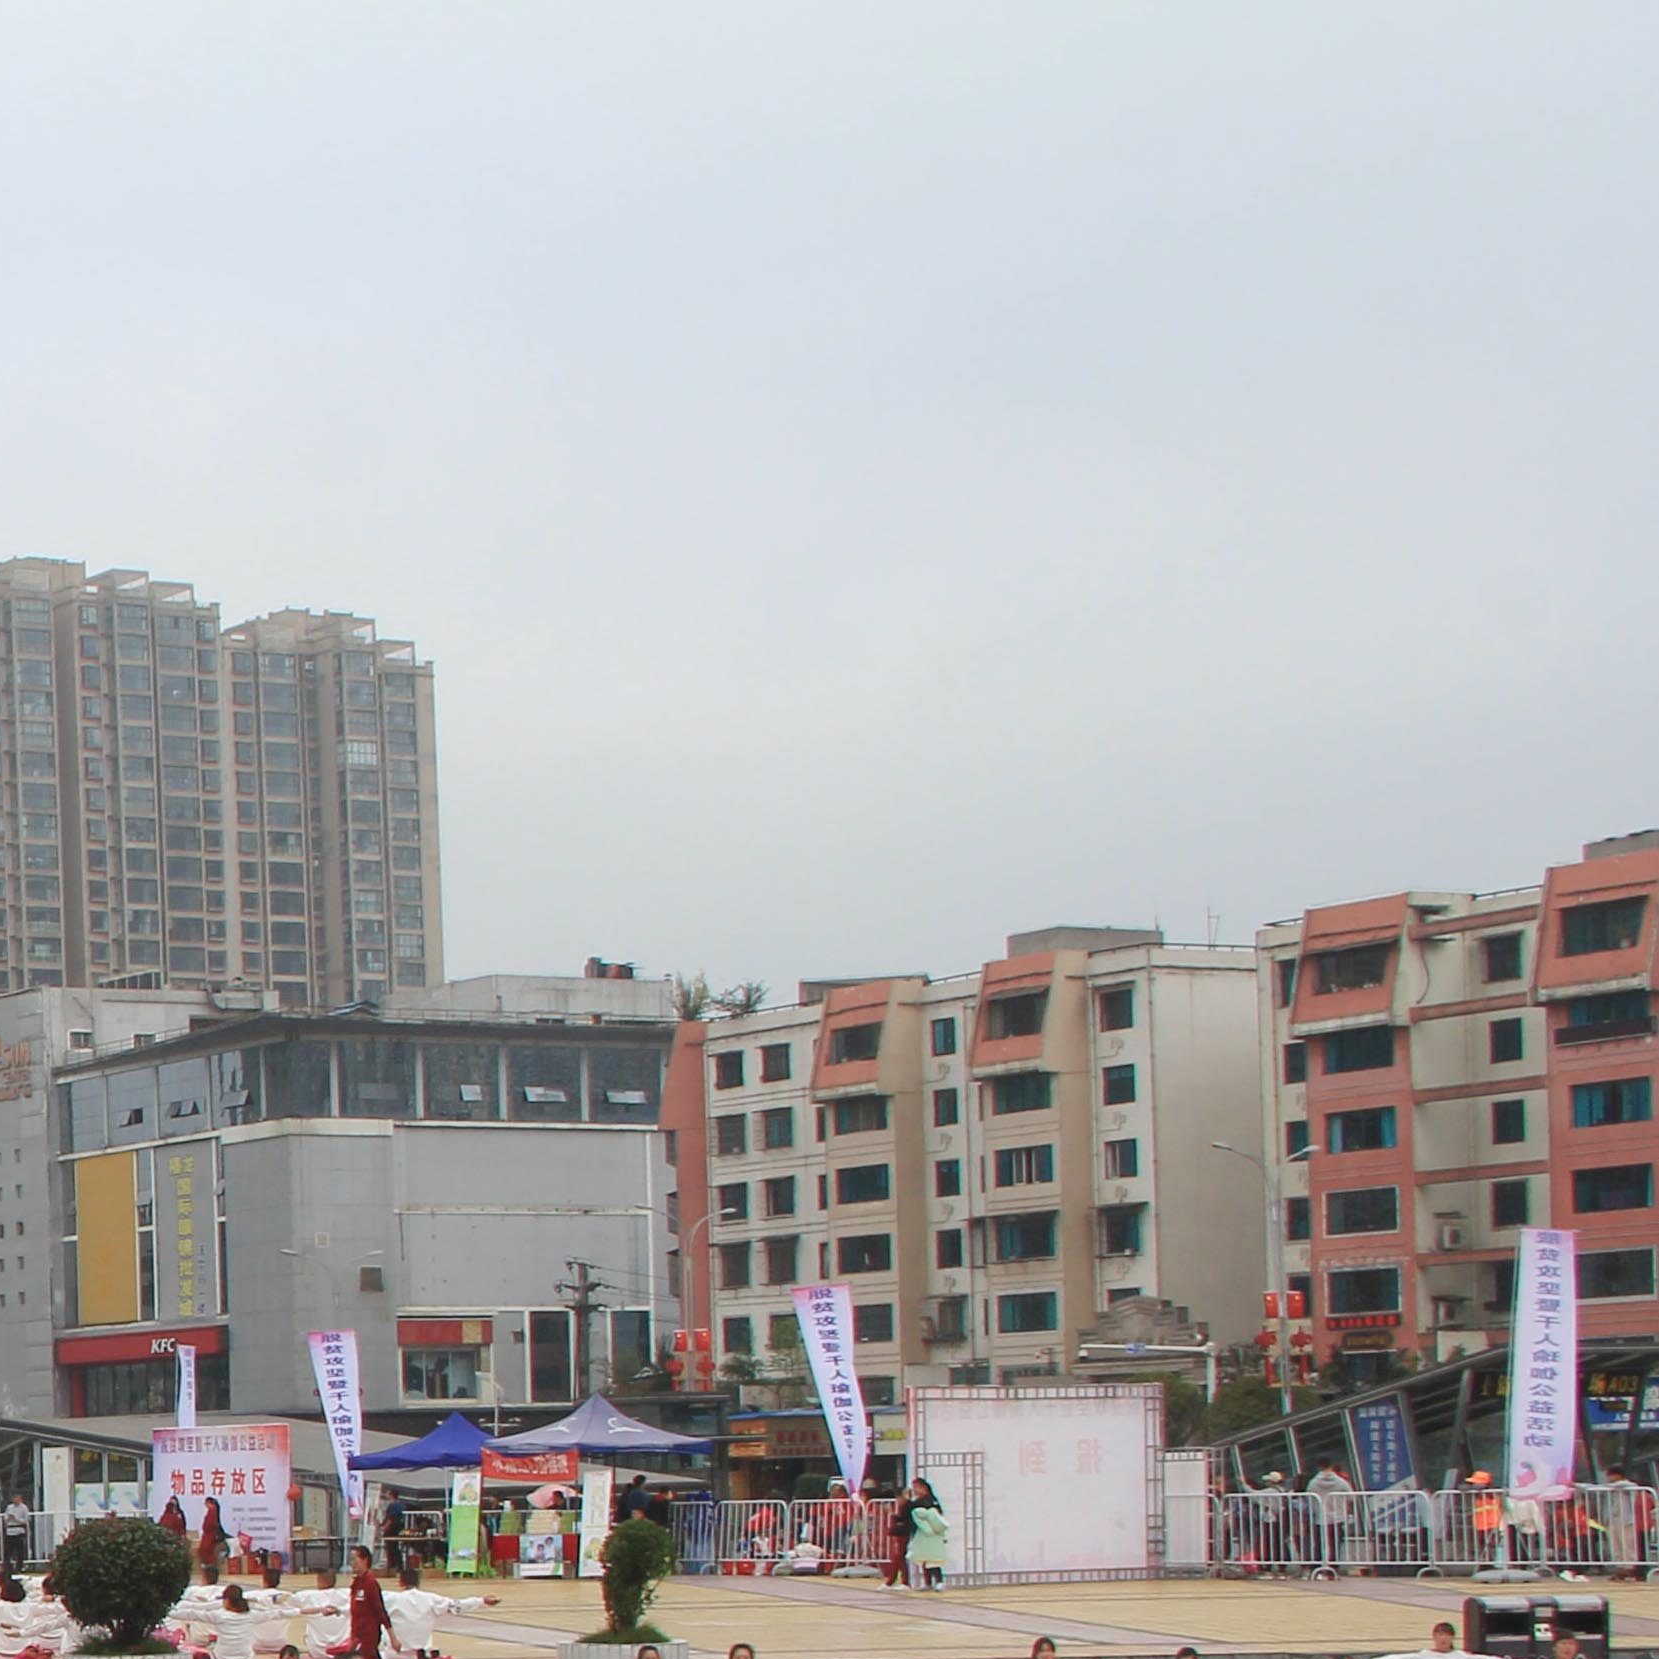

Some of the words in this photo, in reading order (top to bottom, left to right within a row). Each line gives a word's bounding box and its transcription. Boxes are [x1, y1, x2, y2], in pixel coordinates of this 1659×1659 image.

[151, 1338, 176, 1353] KFC
[322, 1333, 358, 1482] 脱贫攻坚暨千人瑜伽公
[170, 1467, 267, 1496] 物品存放区
